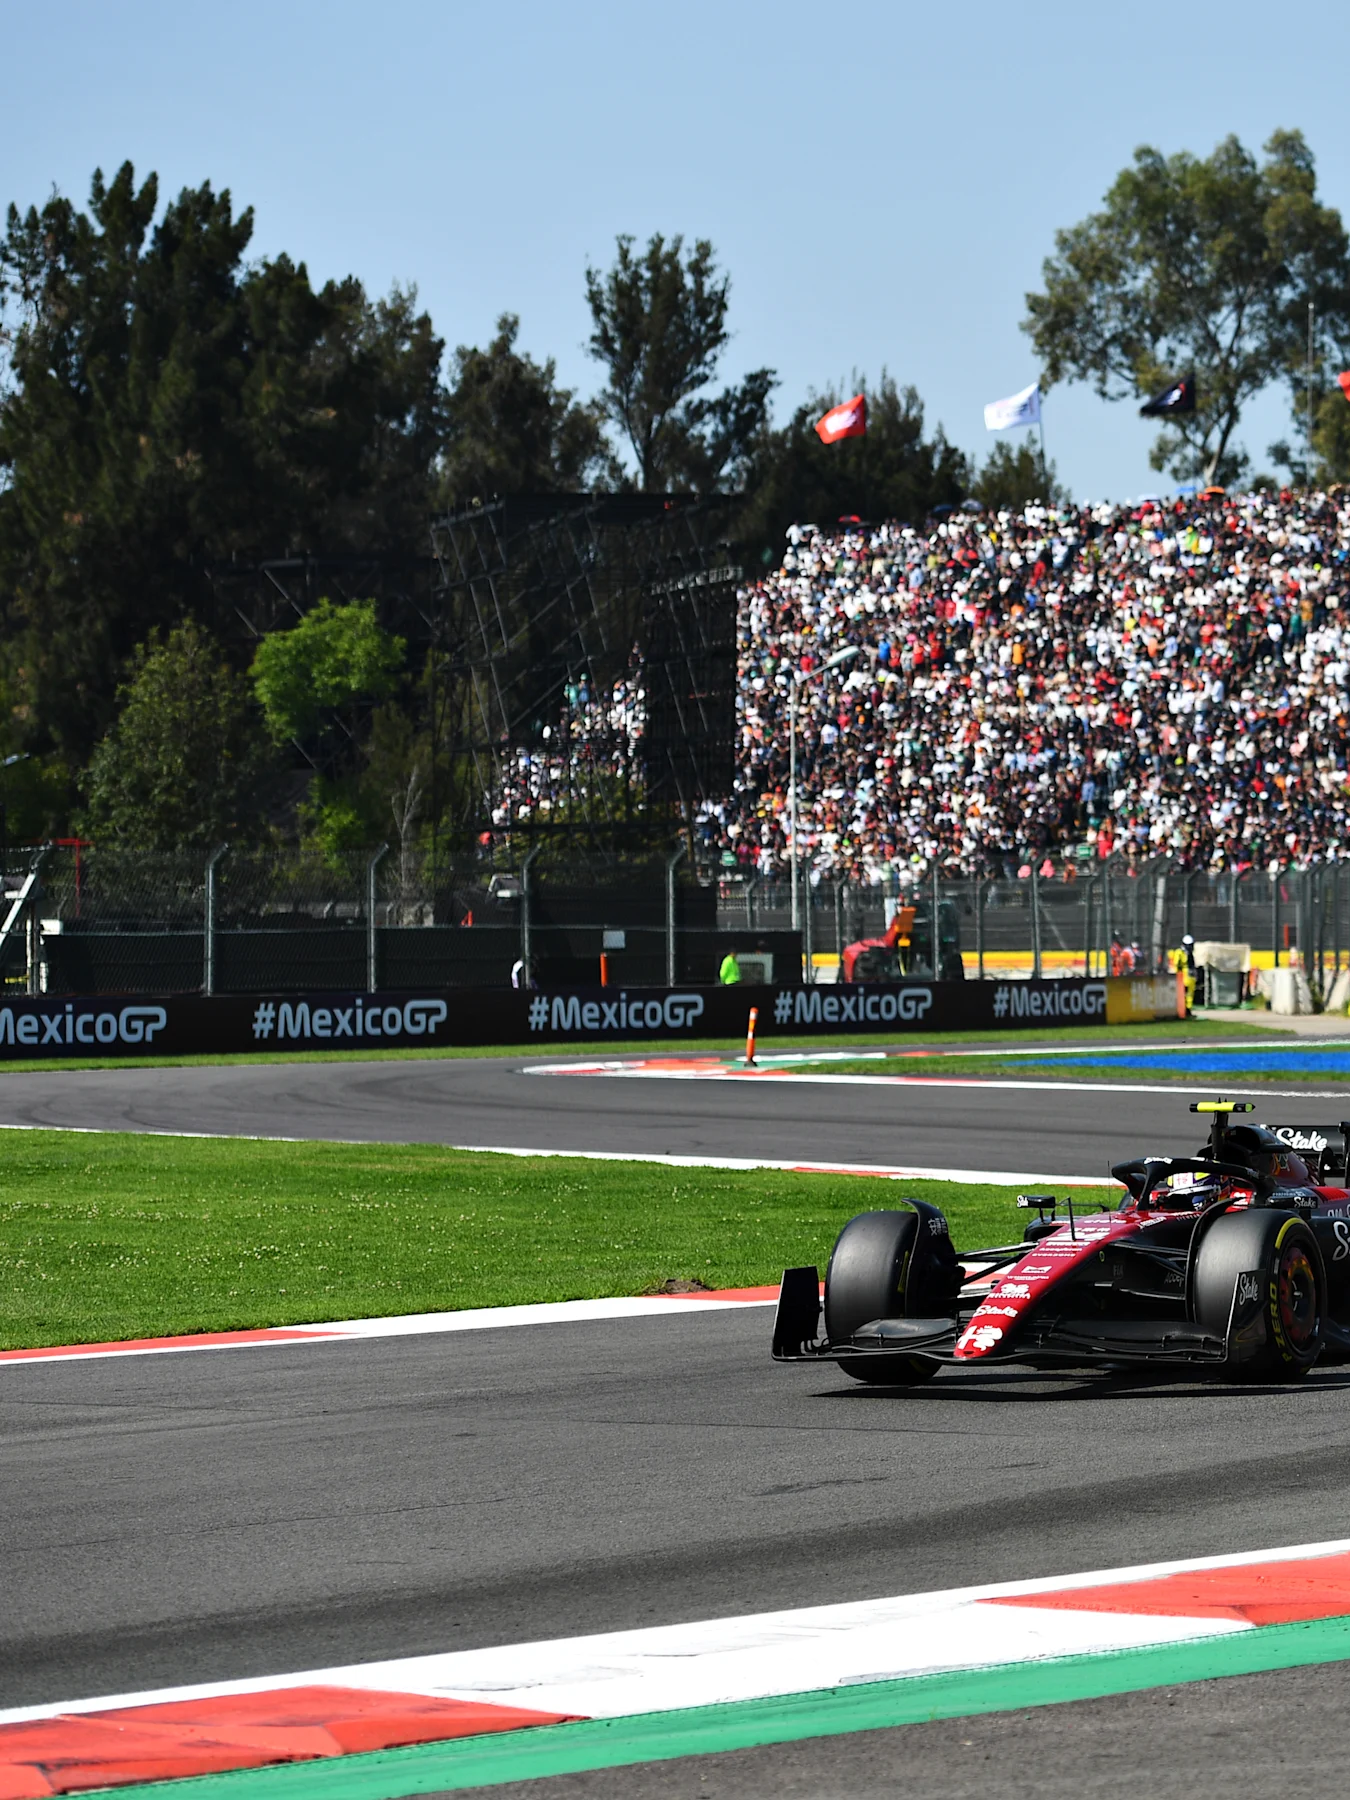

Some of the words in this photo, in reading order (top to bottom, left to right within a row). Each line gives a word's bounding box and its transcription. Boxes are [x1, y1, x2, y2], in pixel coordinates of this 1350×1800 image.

[529, 993, 704, 1031] #MexicoGP
[774, 987, 932, 1024] #MexicoGP
[993, 983, 1108, 1018] #MexicoGP
[252, 998, 447, 1039] #MexicoGP
[1275, 1128, 1328, 1151] Stake
[1293, 1196, 1316, 1208] Stake
[1239, 1273, 1258, 1305] Stake
[973, 1305, 1018, 1317] Stake
[1269, 1282, 1286, 1348] ZERO
